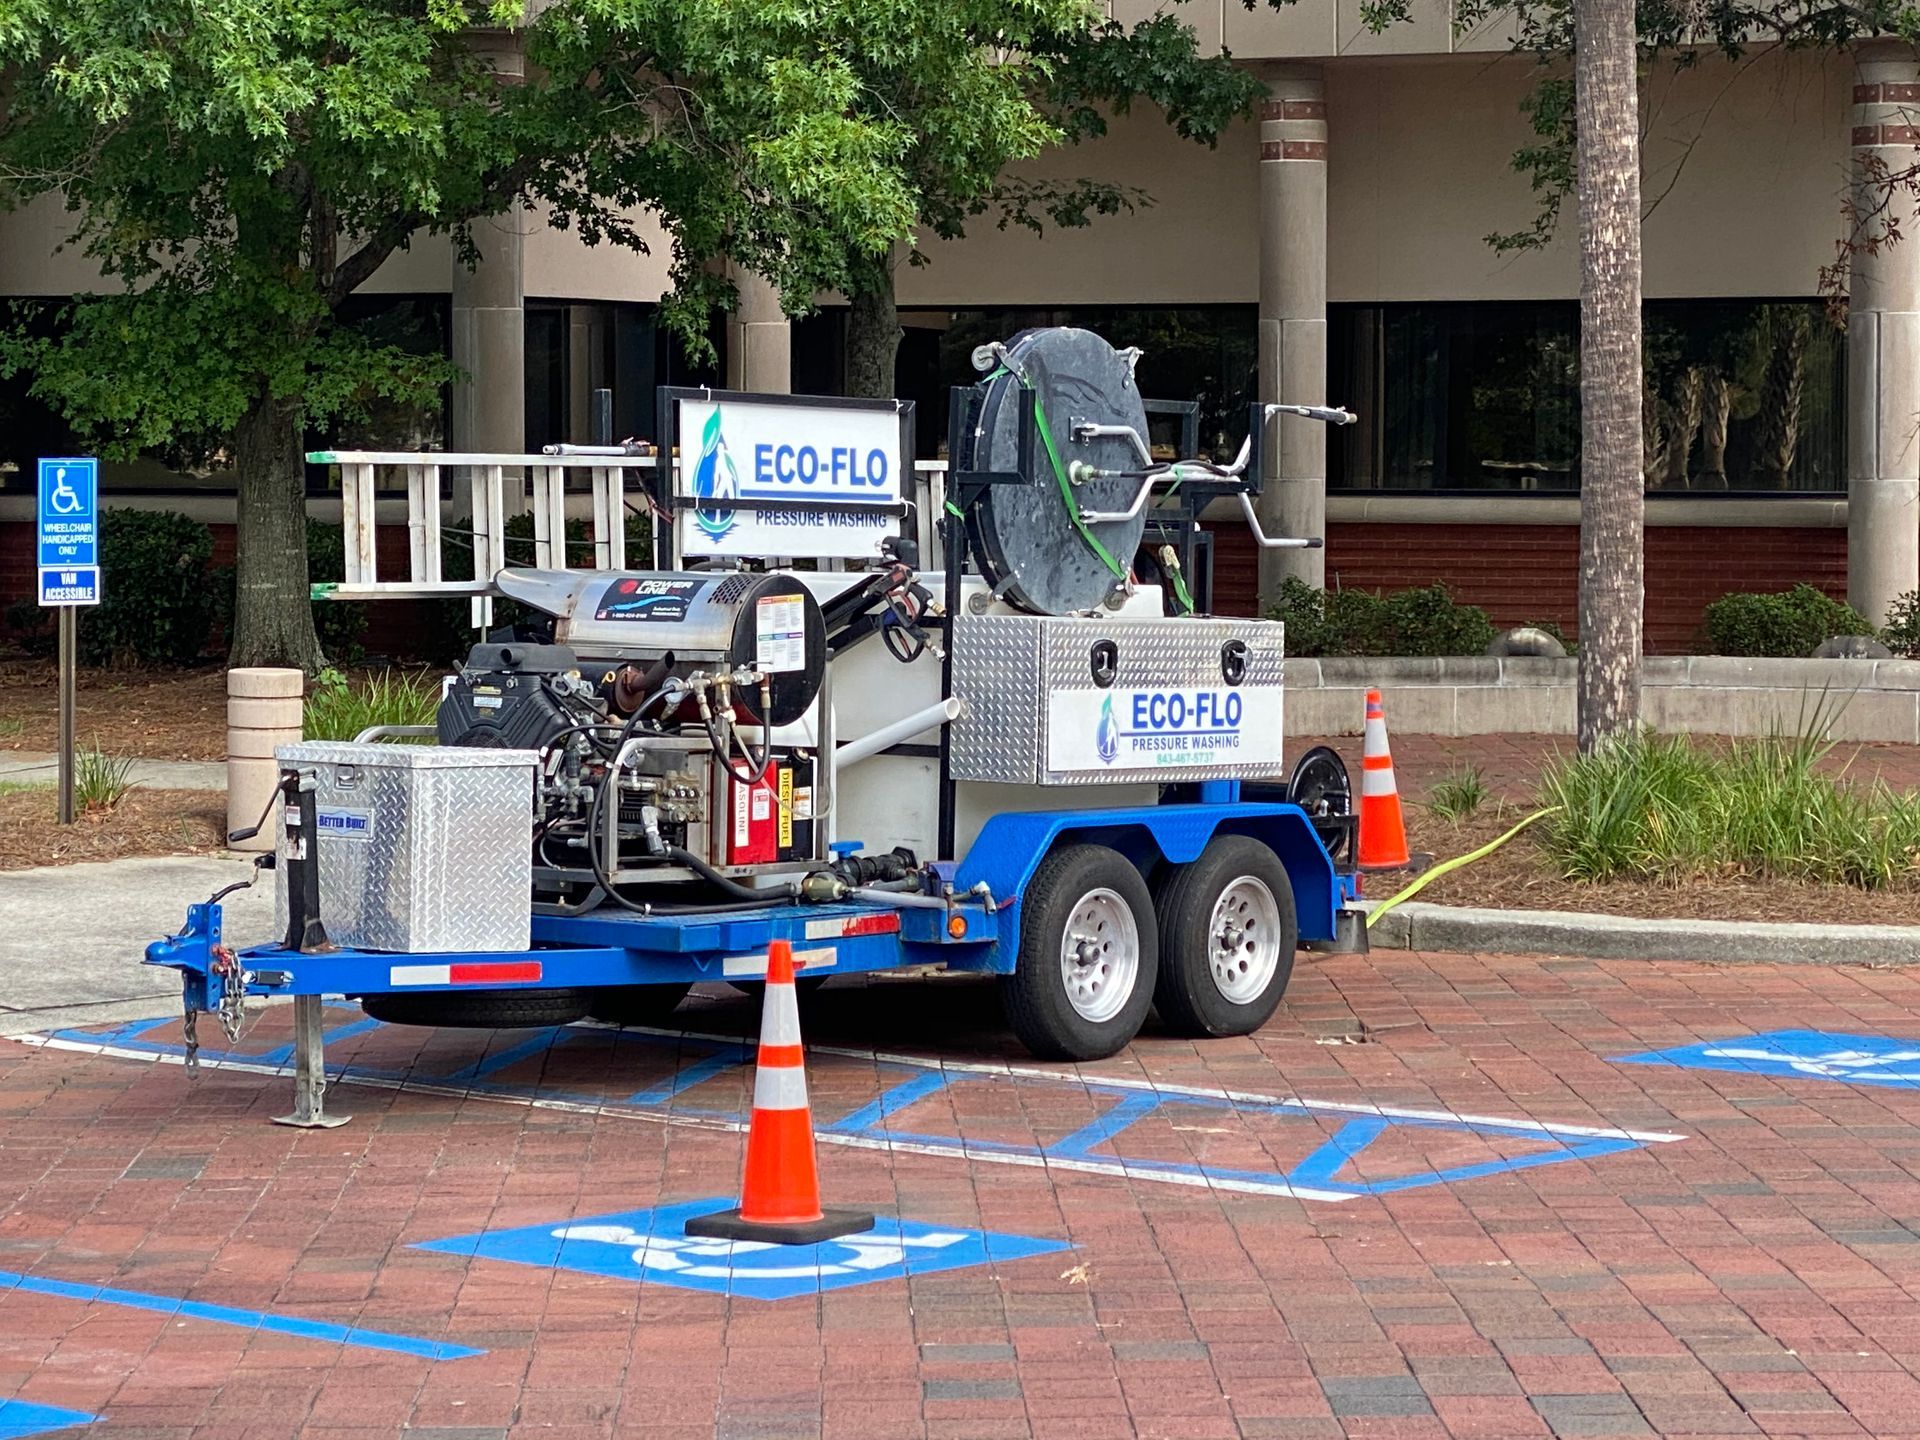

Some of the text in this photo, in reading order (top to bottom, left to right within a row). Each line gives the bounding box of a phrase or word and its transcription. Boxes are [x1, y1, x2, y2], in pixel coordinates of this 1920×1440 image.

[755, 443, 888, 487] ECO-FLO
[756, 510, 887, 528] PRESSURE WASHING
[44, 522, 92, 533] WHEELCHAIR
[42, 534, 93, 545] HANDICAPPED
[58, 546, 77, 556] ONLY
[60, 572, 77, 586] VAN
[640, 580, 694, 589] POWER
[45, 587, 93, 600] ACCESSIBLE
[635, 586, 668, 595] LINE
[1132, 692, 1242, 729] ECO-FLO
[1132, 735, 1240, 751] PRESSURE WASHING
[738, 785, 746, 836] ASOLINE
[319, 815, 344, 828] BETTER
[781, 815, 789, 844] FUEL
